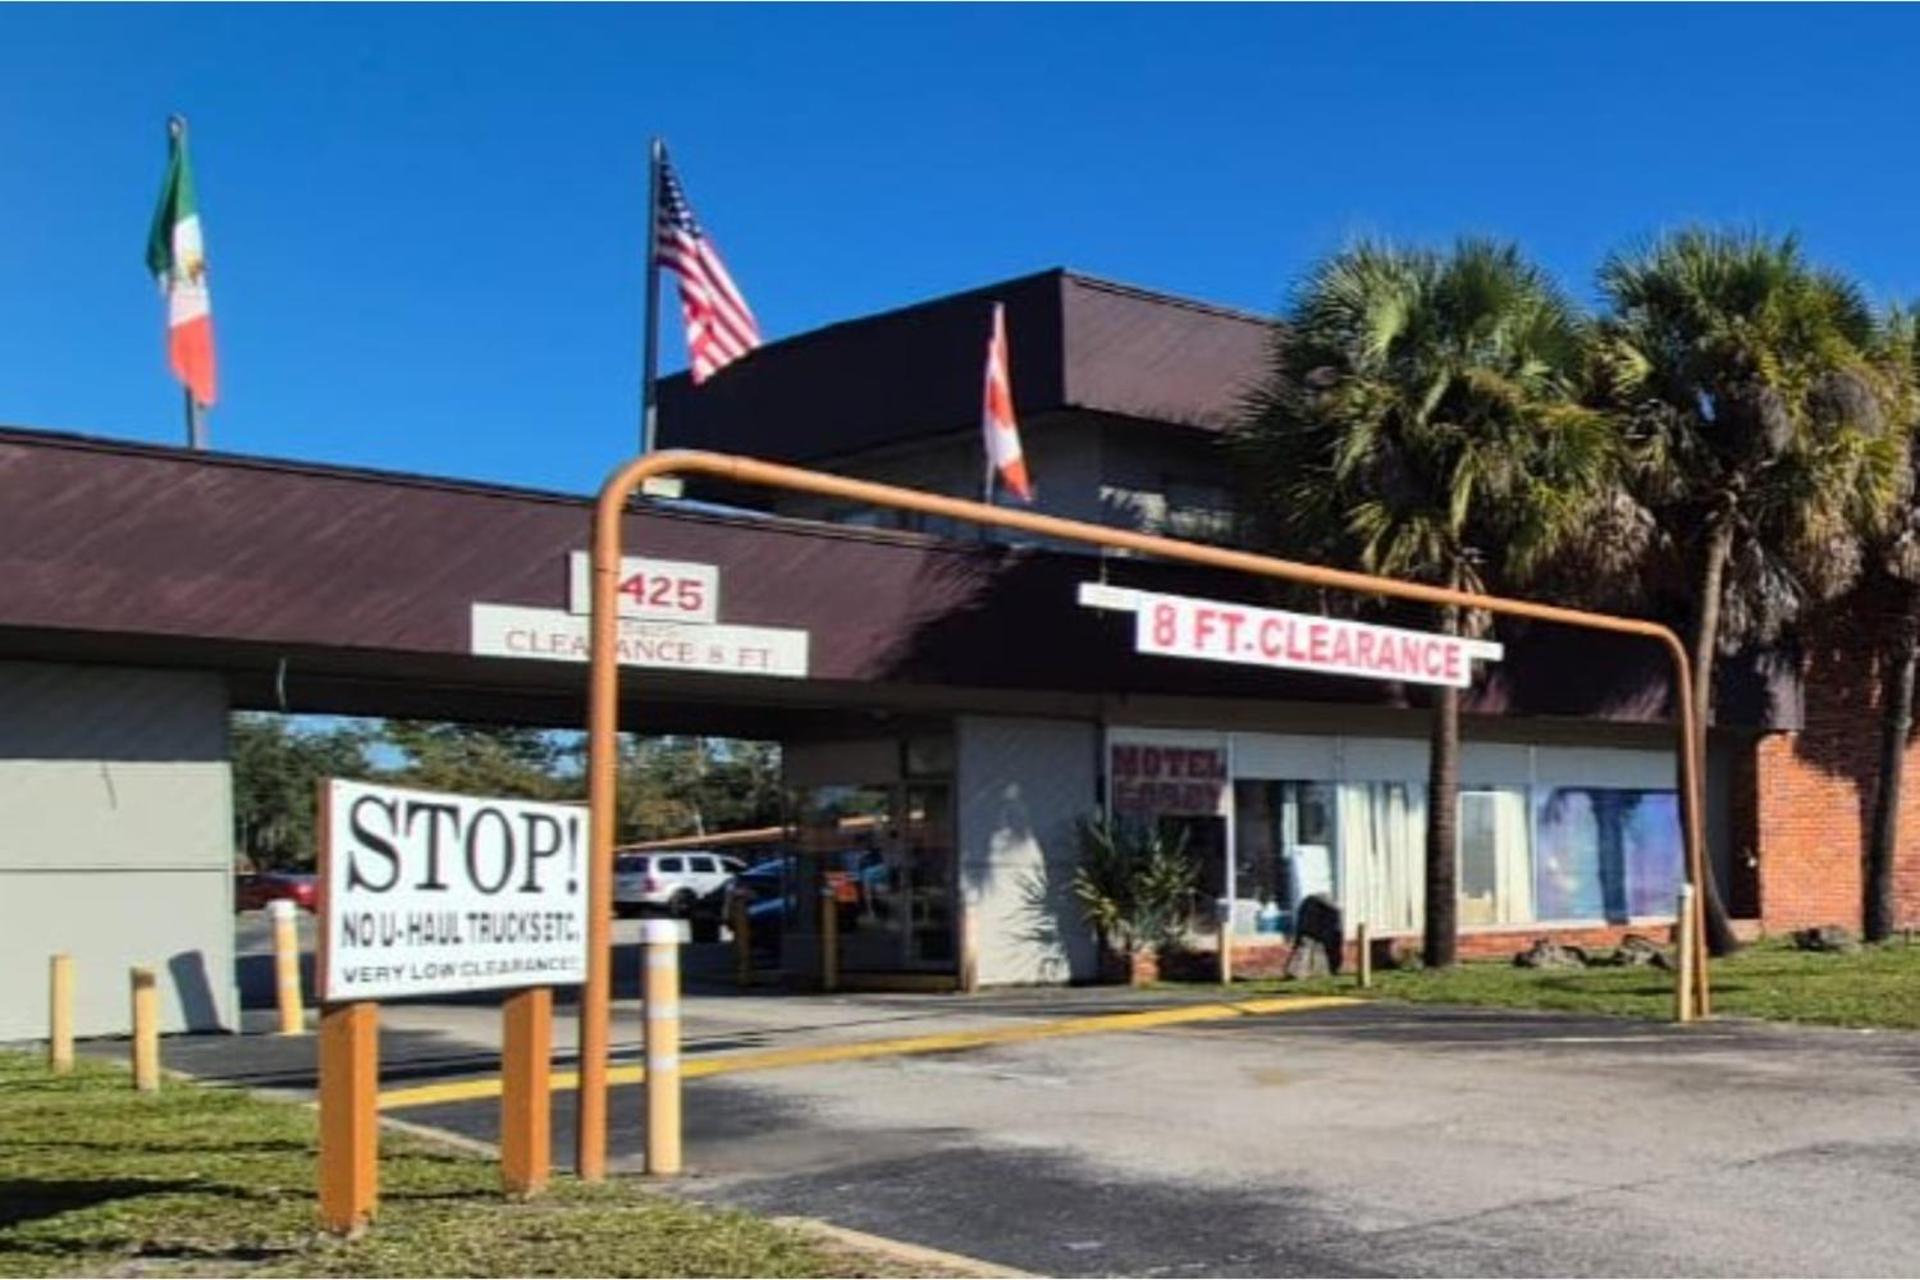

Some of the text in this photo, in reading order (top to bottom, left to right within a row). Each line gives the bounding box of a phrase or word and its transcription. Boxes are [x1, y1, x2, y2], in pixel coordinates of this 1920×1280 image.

[1152, 602, 1178, 647] 8
[504, 630, 697, 664] CLEAANCE
[1111, 744, 1227, 780] MOTEL
[346, 794, 579, 895] STOP!
[341, 911, 375, 948] NO
[380, 910, 463, 947] U-HAUL
[342, 964, 405, 983] VERY
[410, 961, 456, 981] LOW
